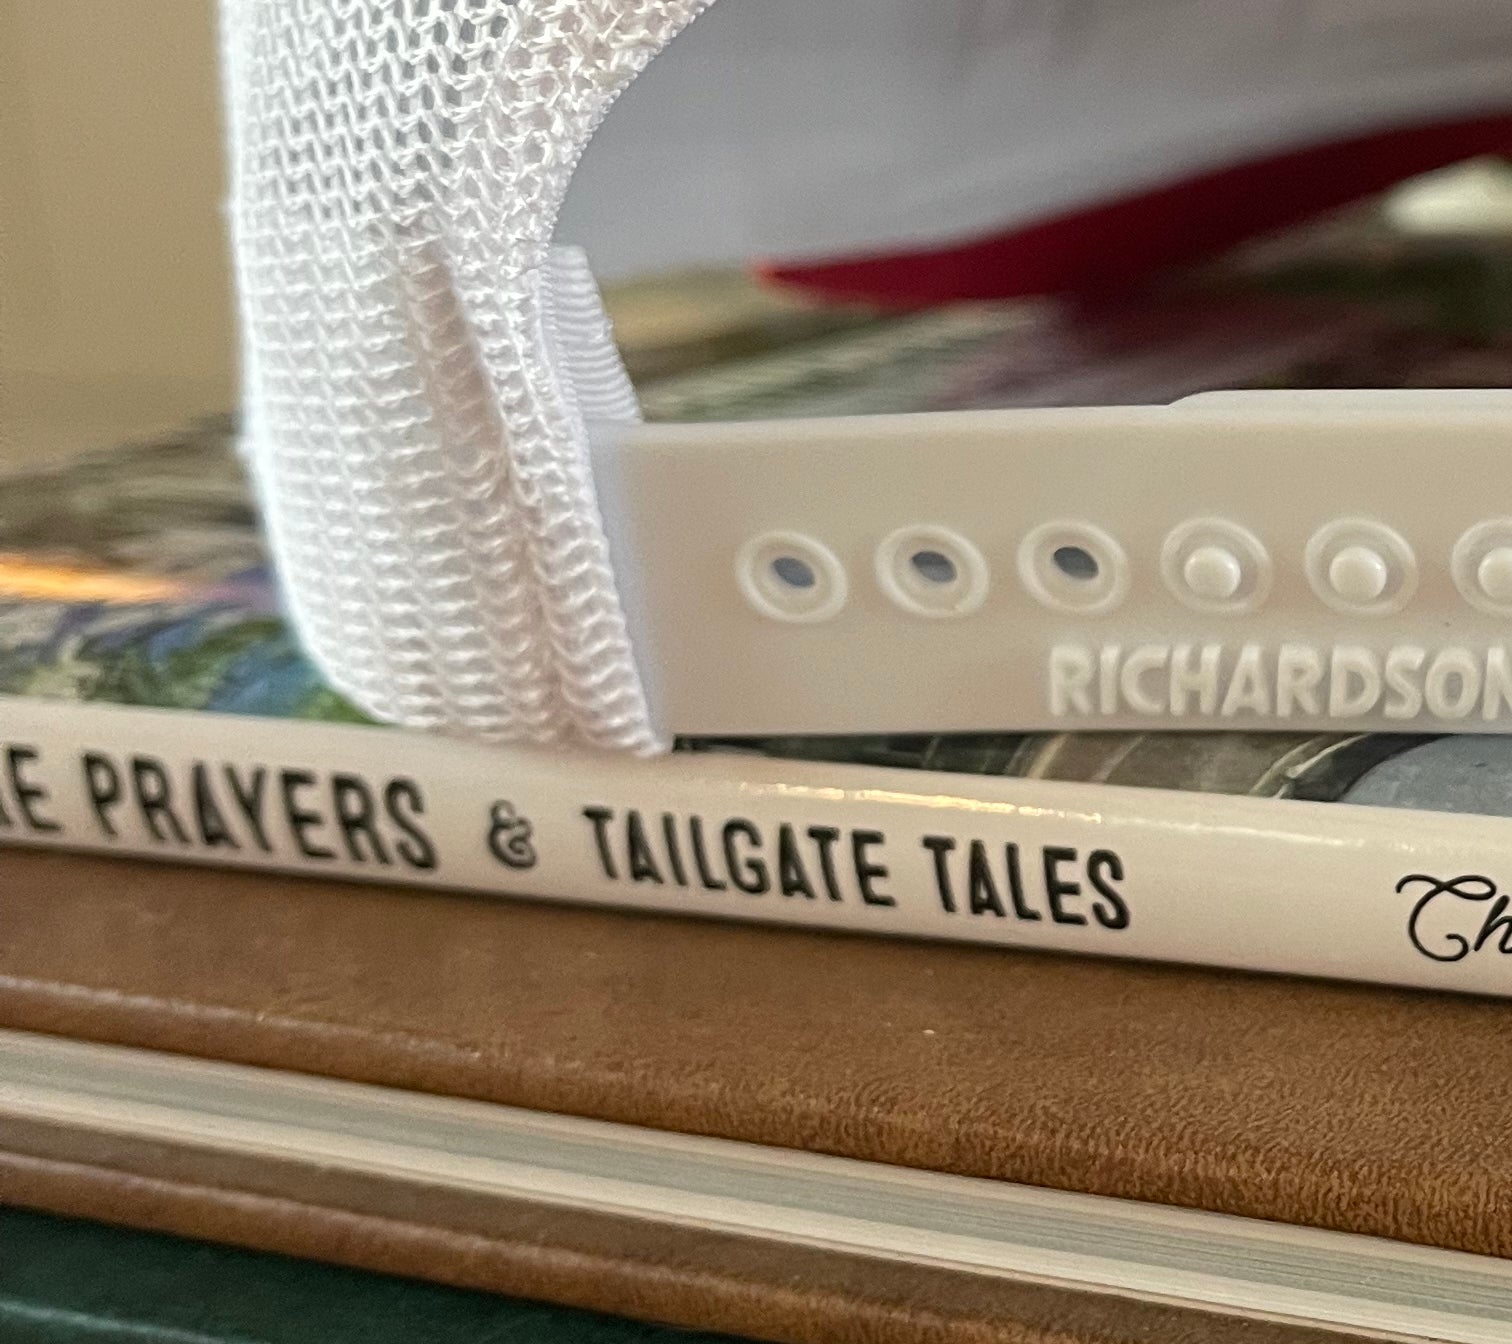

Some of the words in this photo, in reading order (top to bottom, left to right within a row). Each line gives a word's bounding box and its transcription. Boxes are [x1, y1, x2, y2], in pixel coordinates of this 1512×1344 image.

[81, 752, 438, 869] PRAYERS
[486, 800, 537, 867] &
[583, 804, 896, 907] TAILGATE
[921, 834, 1130, 931] TALES
